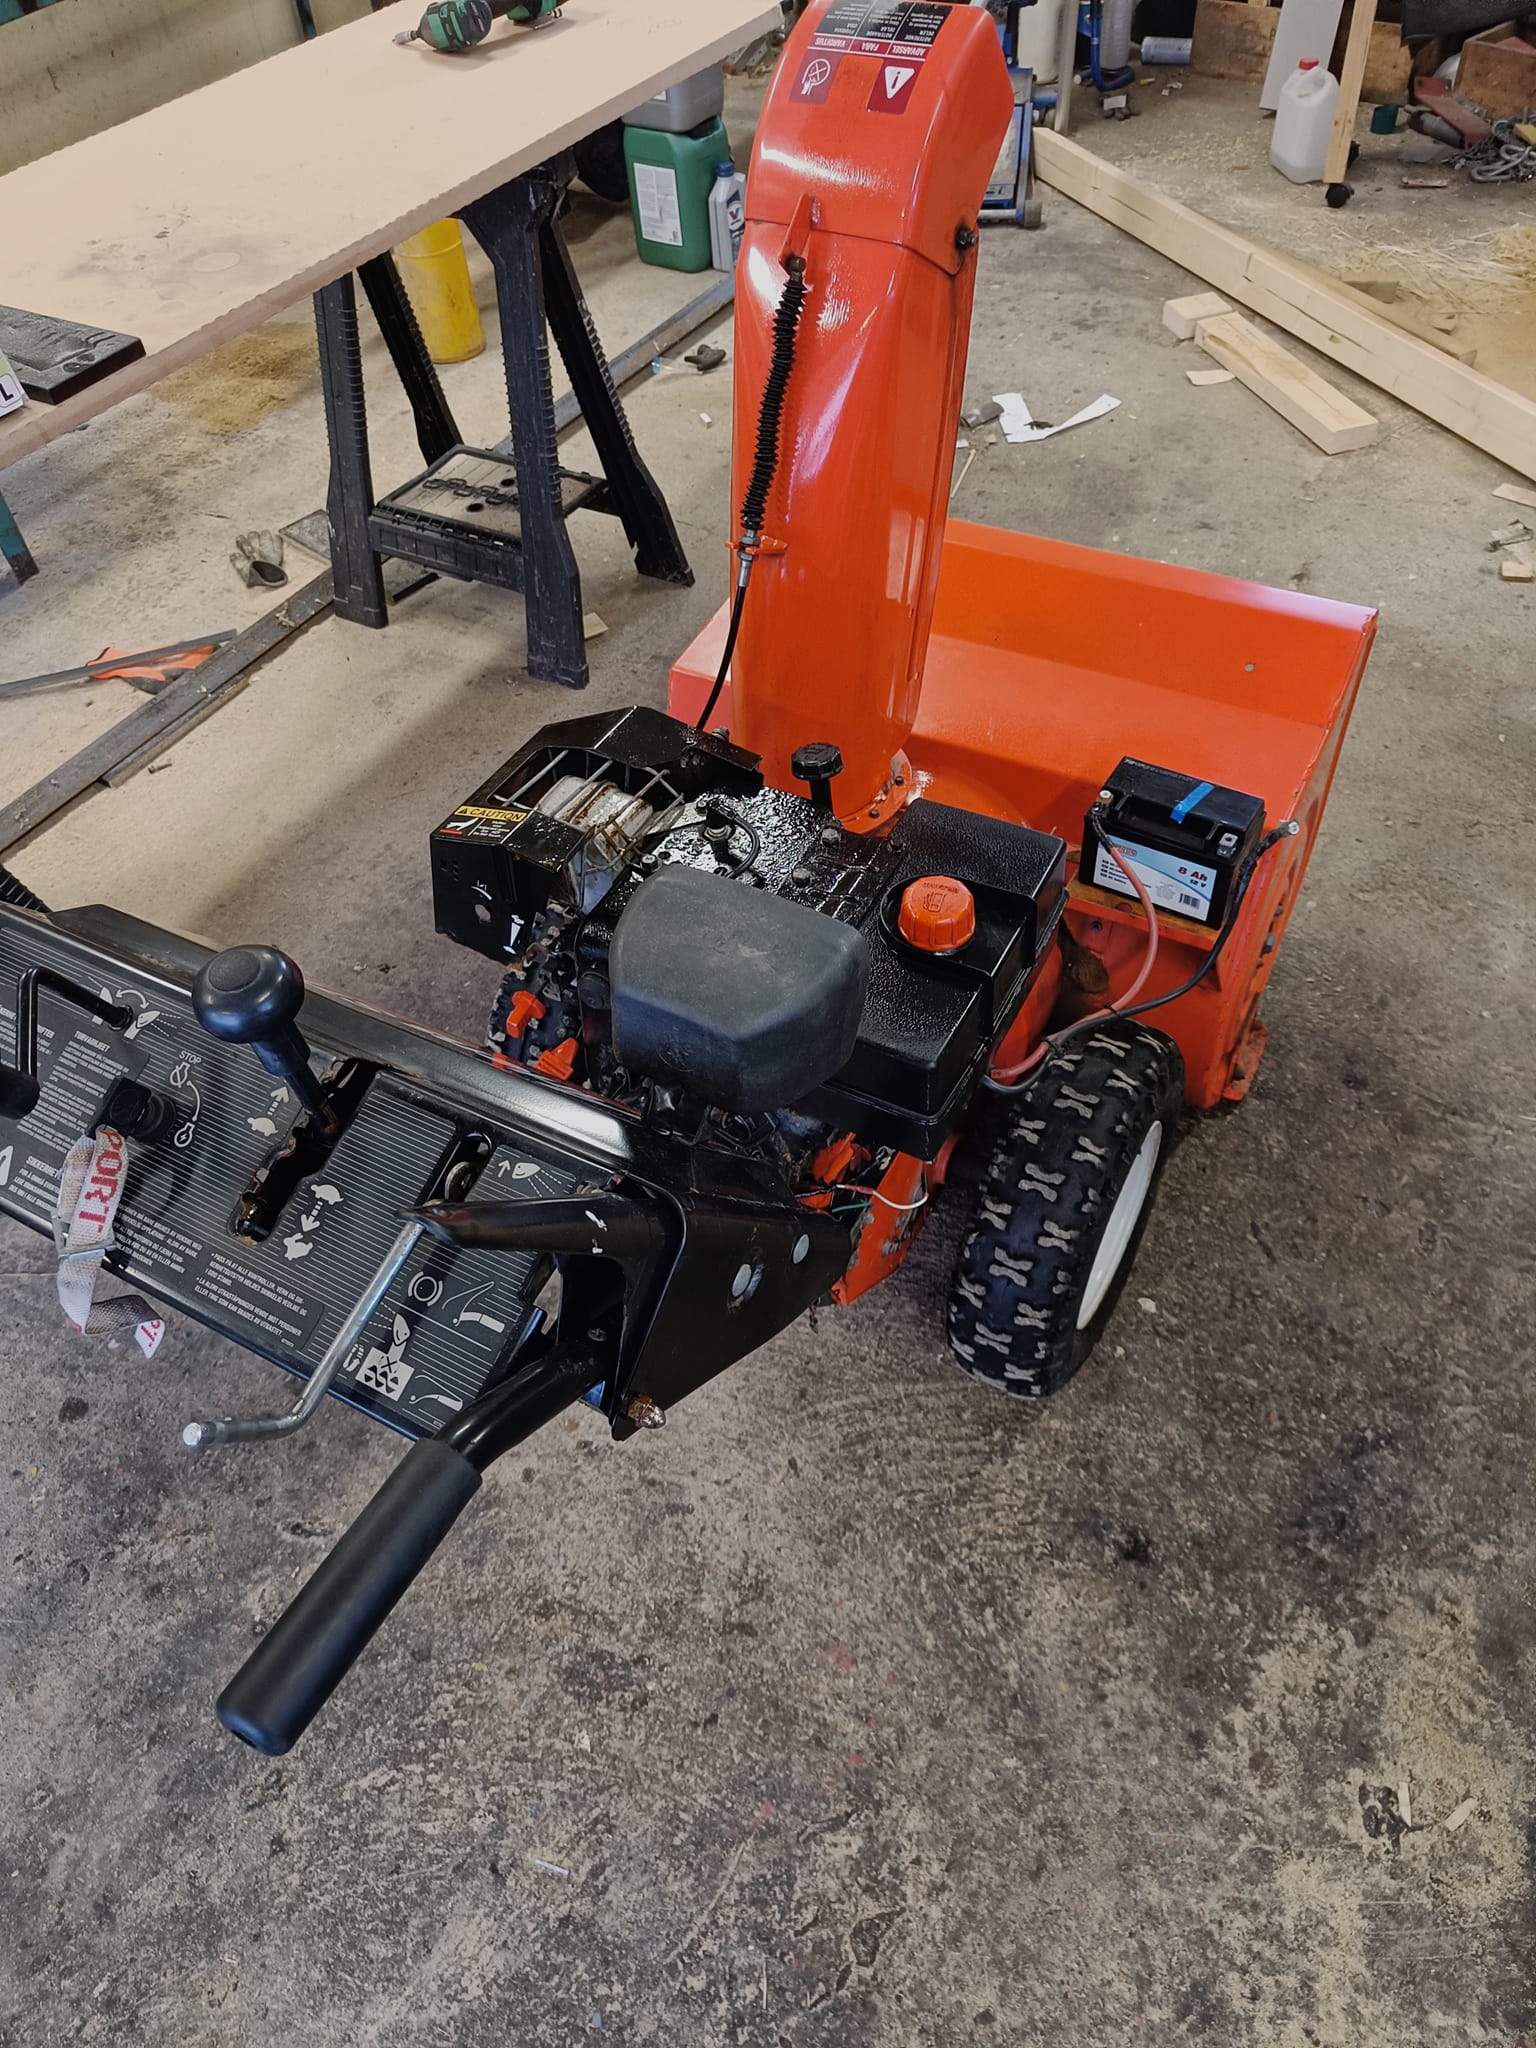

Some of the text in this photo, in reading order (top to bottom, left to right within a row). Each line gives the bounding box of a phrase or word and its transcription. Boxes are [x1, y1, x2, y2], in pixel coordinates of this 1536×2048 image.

[892, 45, 926, 56] ADVARSEL
[470, 808, 524, 821] CAUTION
[1178, 866, 1208, 881] 8 Ah
[179, 1050, 202, 1065] STOP
